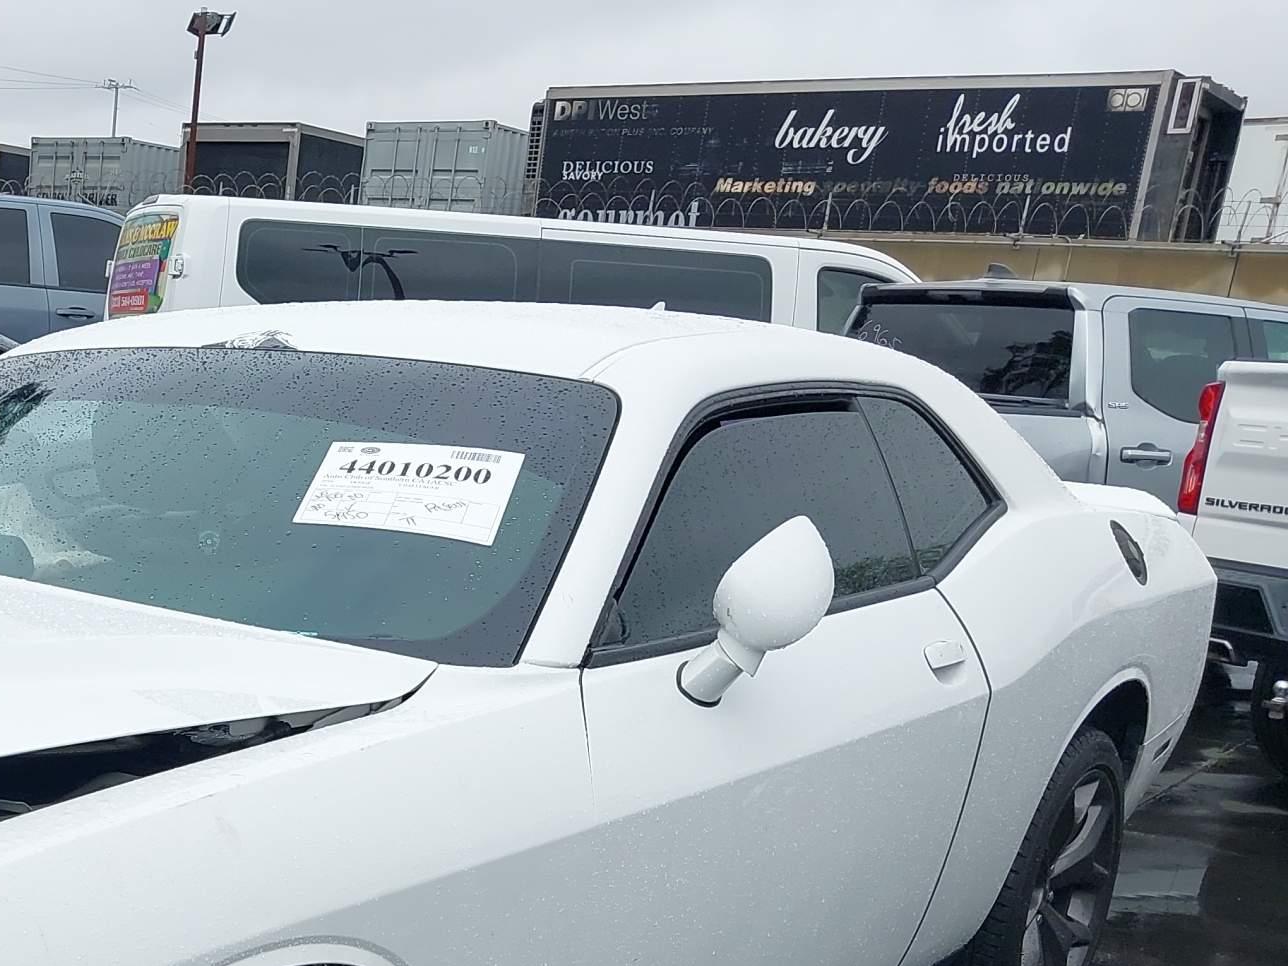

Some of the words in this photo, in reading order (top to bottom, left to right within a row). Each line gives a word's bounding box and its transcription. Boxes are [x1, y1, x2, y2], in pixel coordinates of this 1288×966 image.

[599, 100, 648, 120] West
[947, 93, 1021, 146] fresh
[775, 109, 889, 164] bakery
[936, 127, 1073, 158] imported
[562, 160, 654, 174] DELICIOUS
[562, 171, 604, 181] SAVORY
[715, 177, 817, 196] Marketing
[927, 177, 990, 195] foods
[995, 179, 1128, 196] nationwide
[953, 174, 1030, 182] DELICIOUS
[338, 459, 492, 485] 44010200
